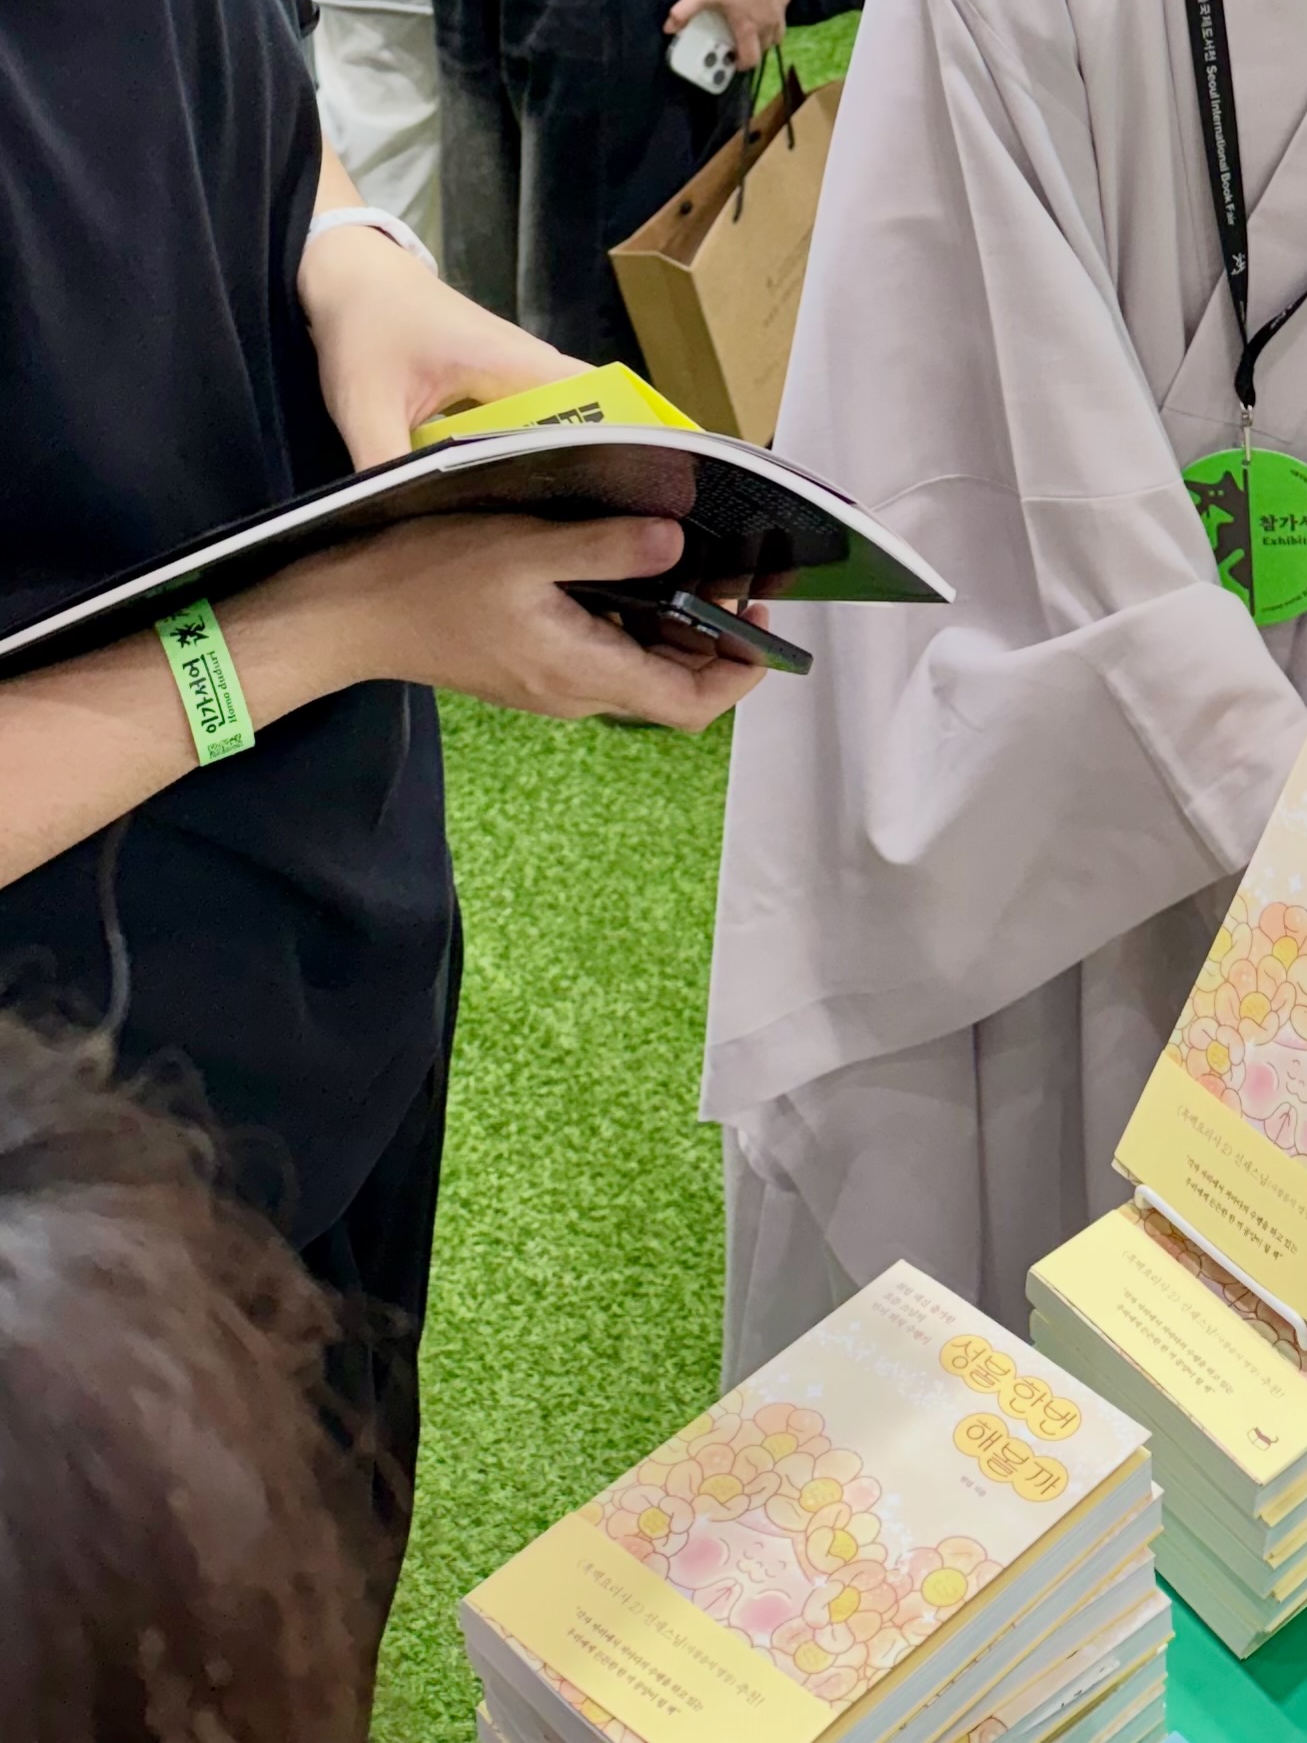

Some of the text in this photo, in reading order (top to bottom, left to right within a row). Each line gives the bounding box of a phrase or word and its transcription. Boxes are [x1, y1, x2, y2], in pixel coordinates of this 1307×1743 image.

[1206, 64, 1219, 98] Seoul
[1210, 98, 1228, 172] International
[1220, 171, 1233, 201] Book
[1225, 200, 1235, 227] Fair
[207, 650, 238, 724] Homo duduri
[945, 1335, 1078, 1435] 성불 한번
[963, 1418, 1062, 1499] 해볼까
